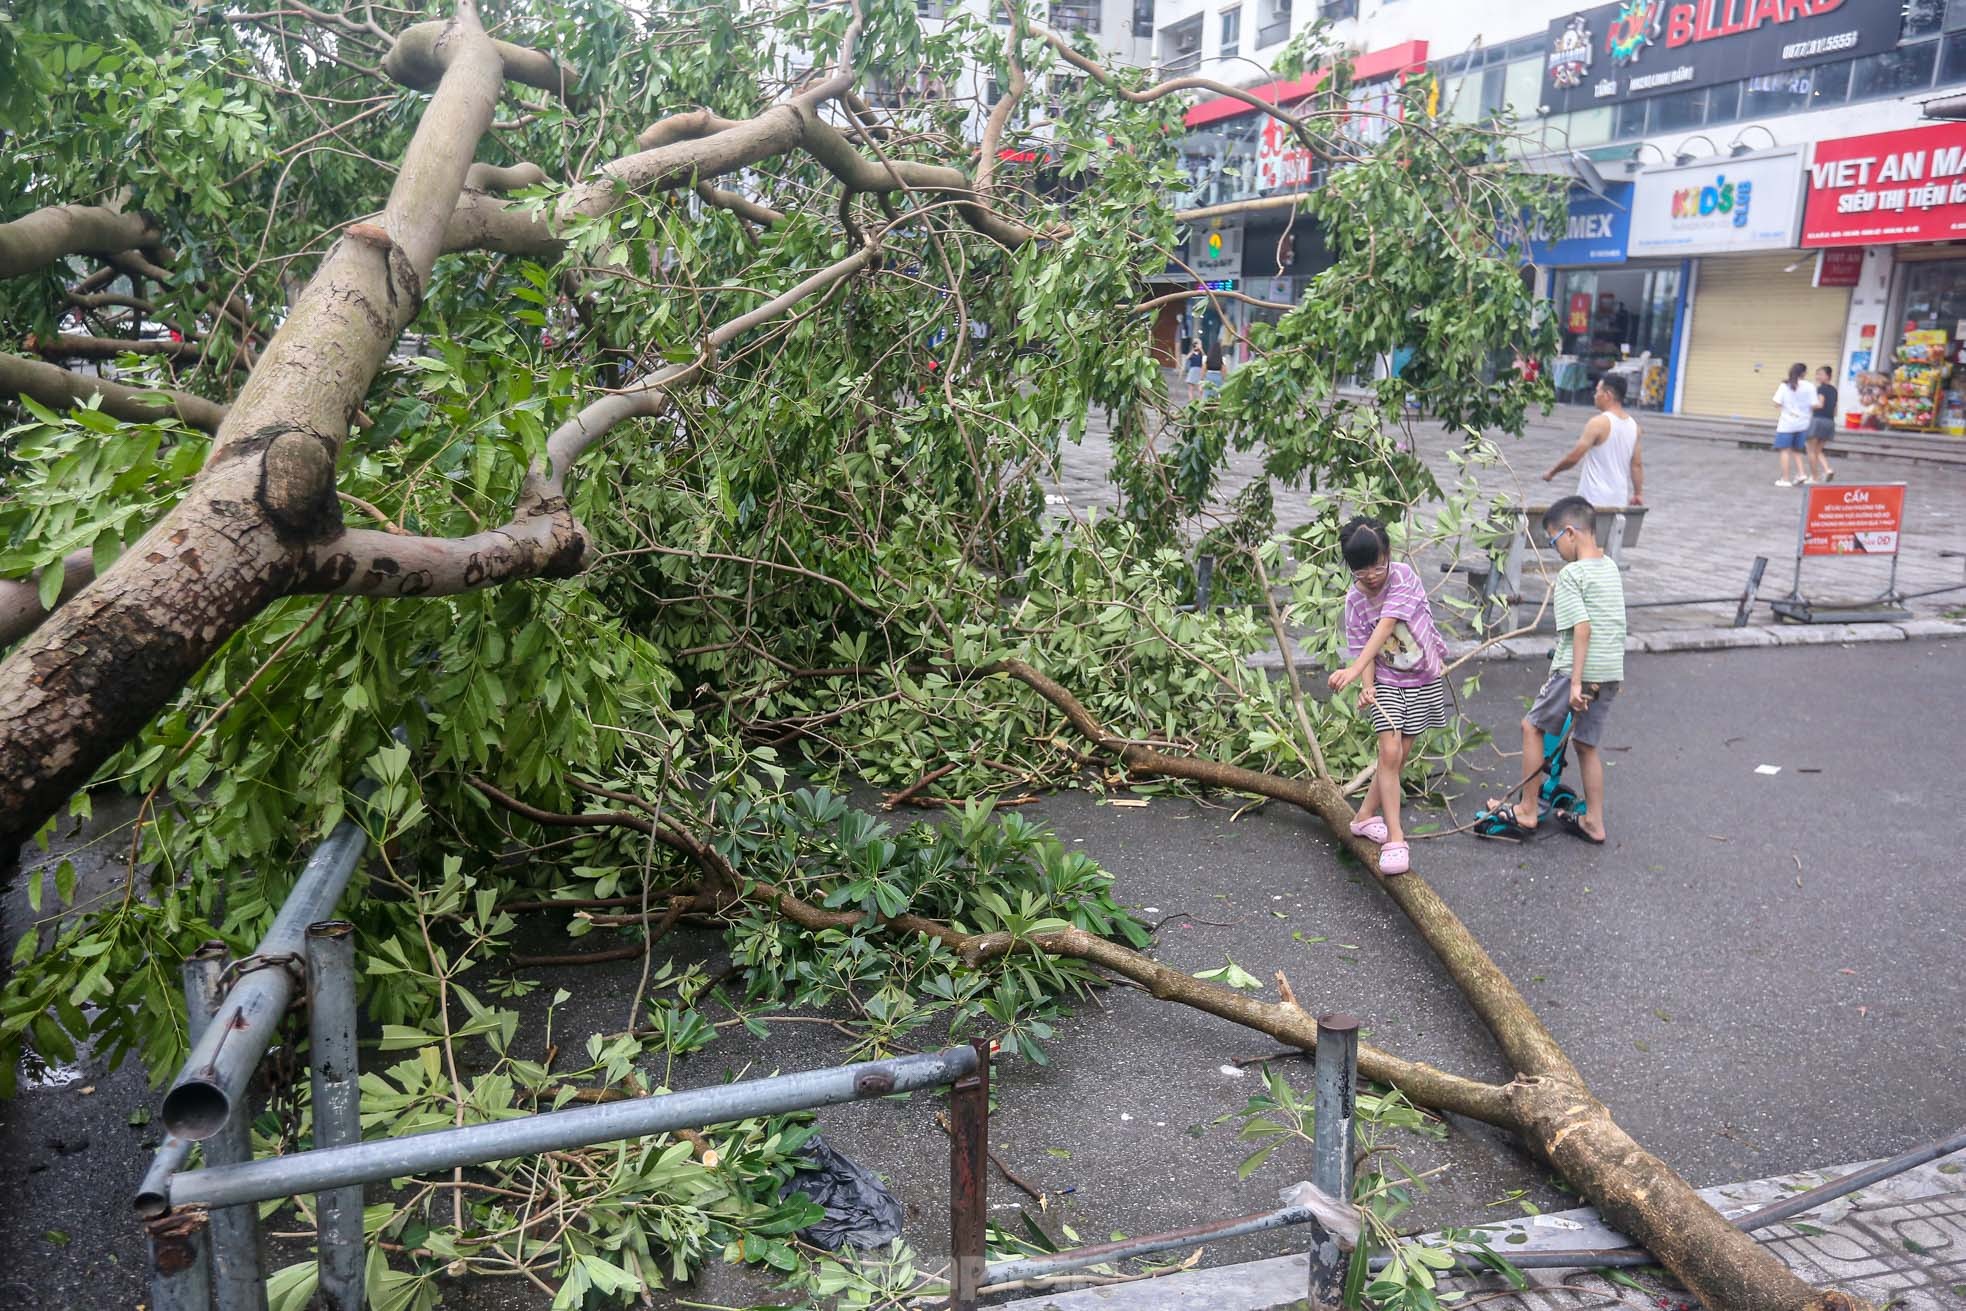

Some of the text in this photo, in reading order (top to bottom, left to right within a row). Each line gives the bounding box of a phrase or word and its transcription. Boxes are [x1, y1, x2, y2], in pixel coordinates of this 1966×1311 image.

[1812, 157, 1876, 189] VIET
[1876, 151, 1926, 184] AN
[1836, 188, 1877, 214] SIÊU
[1907, 182, 1949, 211] TIỆN
[1843, 488, 1870, 503] CẤM
